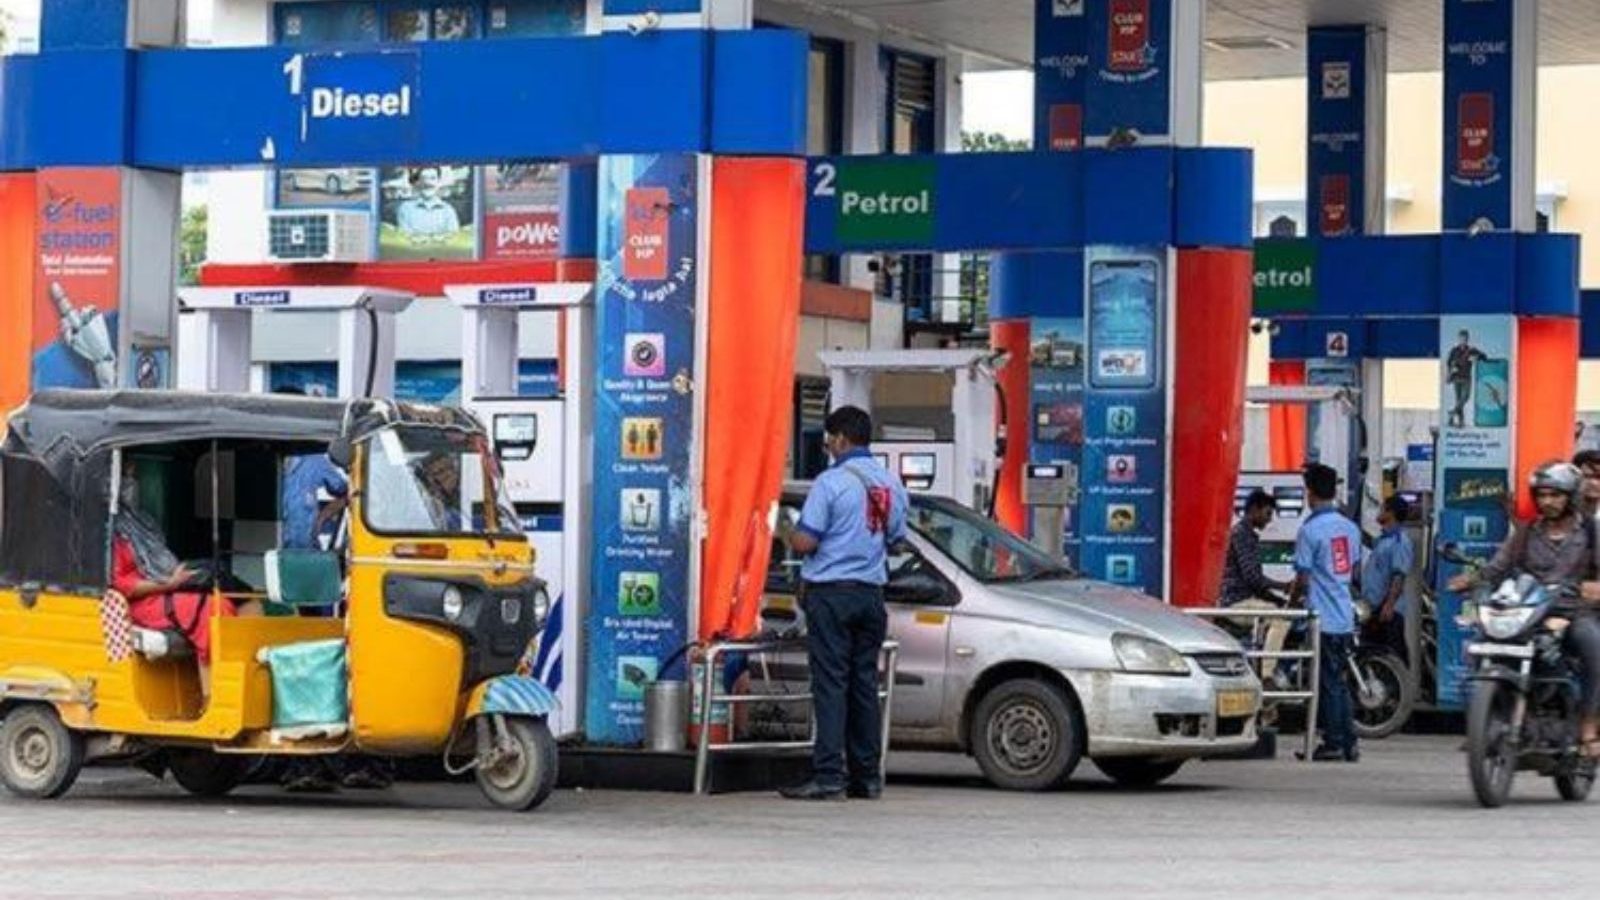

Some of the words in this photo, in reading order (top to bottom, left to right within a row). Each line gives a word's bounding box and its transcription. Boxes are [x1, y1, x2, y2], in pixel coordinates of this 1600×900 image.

[283, 53, 303, 95] 1
[312, 85, 411, 118] Diesel
[813, 163, 836, 196] 2
[841, 189, 929, 215] Petrol
[41, 231, 113, 251] station
[629, 231, 662, 246] CLUB
[240, 291, 285, 305] Diesel
[483, 288, 530, 303] Diesel
[1329, 334, 1345, 352] 4
